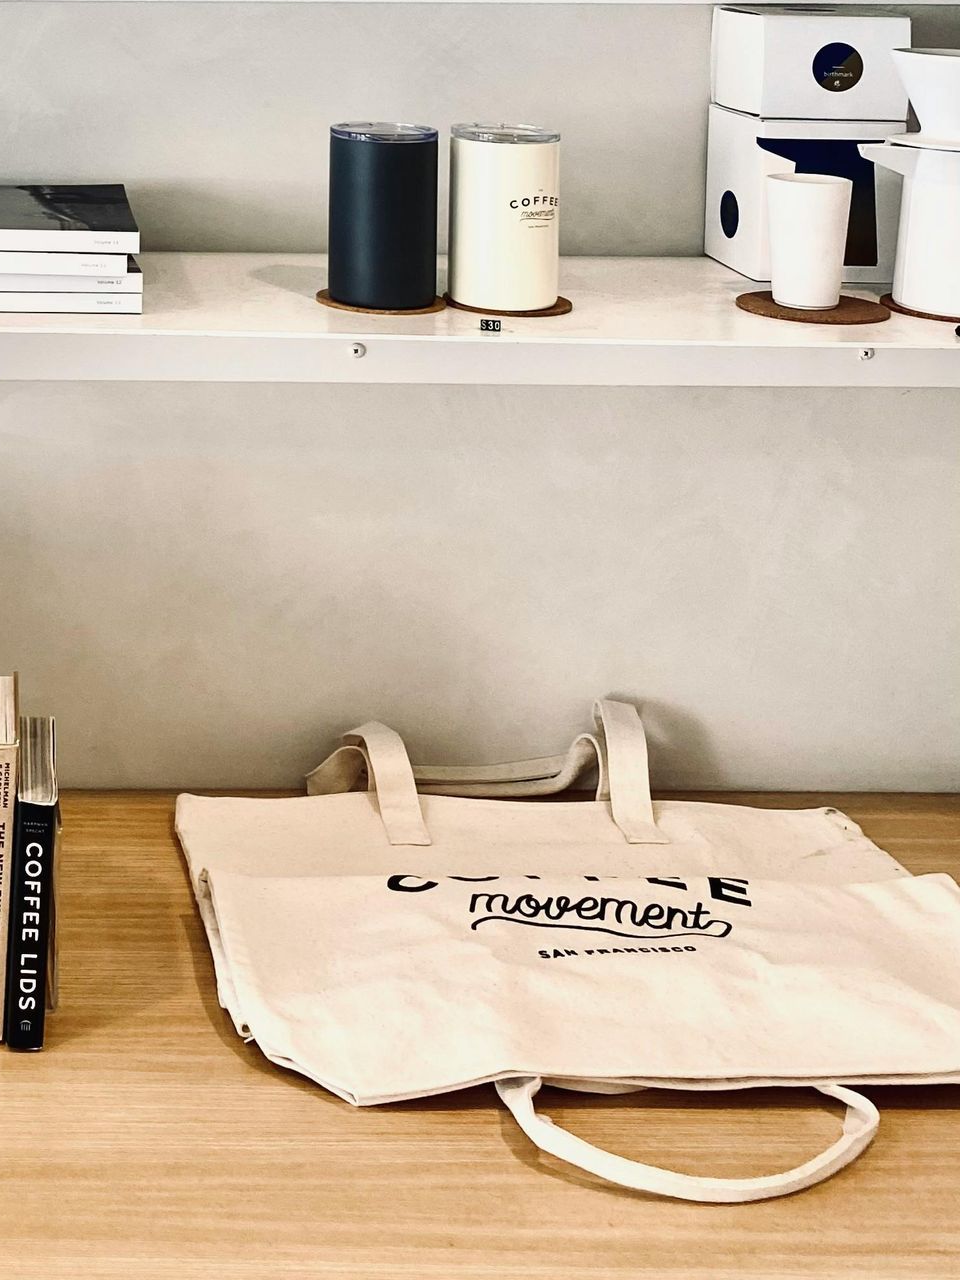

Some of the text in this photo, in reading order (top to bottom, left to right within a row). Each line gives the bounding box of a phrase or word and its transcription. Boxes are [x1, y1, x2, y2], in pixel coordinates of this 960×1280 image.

[509, 195, 559, 210] COFFEE
[480, 319, 501, 331] $30
[2, 762, 11, 809] MICHELMAN
[18, 842, 43, 1011] COFFEE LIDS
[469, 892, 733, 939] movement
[538, 945, 697, 959] SAN FRANCISCO
